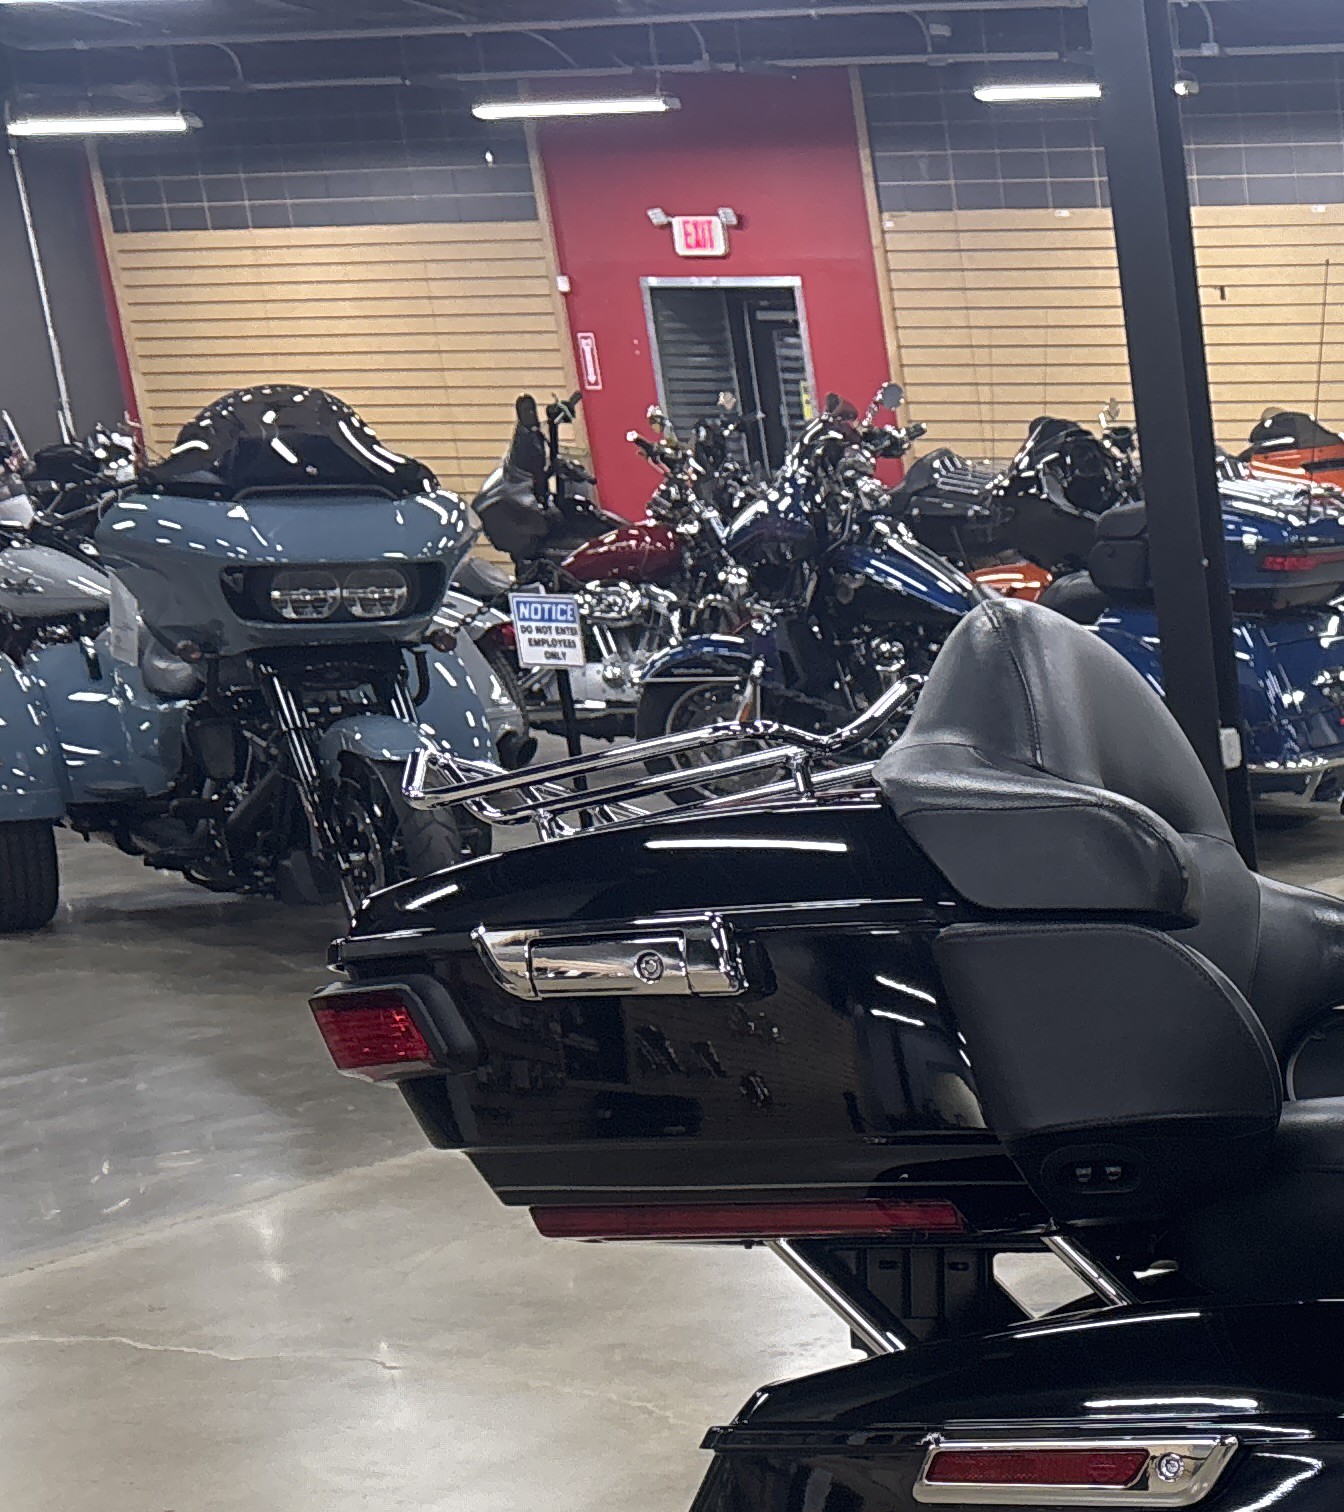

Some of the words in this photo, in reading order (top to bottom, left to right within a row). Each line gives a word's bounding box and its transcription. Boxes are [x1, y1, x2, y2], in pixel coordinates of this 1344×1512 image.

[682, 219, 714, 249] EXIT
[519, 602, 575, 620] NOTICE
[520, 624, 533, 635] DO
[535, 625, 553, 636] NOT
[528, 637, 577, 649] EMPLOYEES
[543, 650, 567, 661] ONLY
